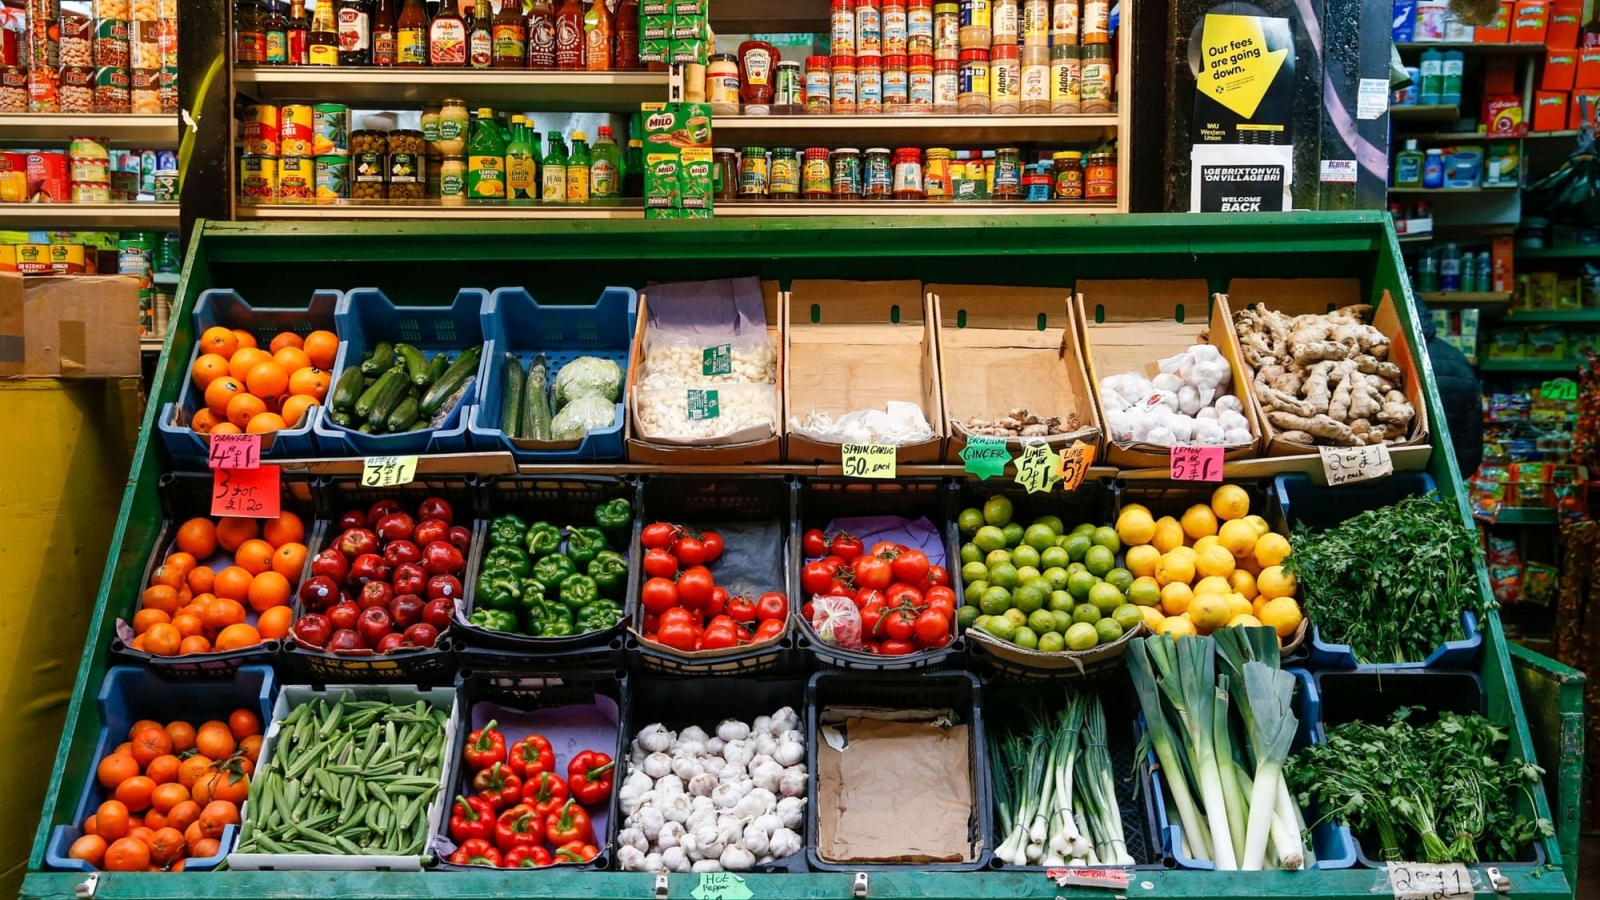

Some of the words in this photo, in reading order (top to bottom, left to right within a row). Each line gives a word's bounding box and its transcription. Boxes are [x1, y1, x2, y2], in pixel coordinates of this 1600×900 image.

[1209, 45, 1228, 57] Our
[1230, 38, 1253, 51] fees
[1211, 58, 1228, 69] are
[1230, 48, 1261, 65] going
[1213, 65, 1245, 80] down.
[998, 67, 1007, 94] Adobo
[1060, 66, 1069, 94] Adobo
[649, 117, 672, 127] MILO
[657, 166, 675, 174] MILO
[691, 166, 708, 174] MILO
[1221, 203, 1261, 212] BACK
[214, 434, 252, 442] ORANGES
[210, 444, 230, 468] 4
[963, 446, 1004, 460] GINGER
[1024, 448, 1047, 459] LIME
[1064, 448, 1084, 459] LIME
[1173, 446, 1202, 455] LEMON
[872, 463, 891, 473] EACH
[1172, 456, 1186, 479] 5
[1328, 453, 1356, 471] 2
[366, 465, 384, 486] 3
[1020, 458, 1034, 482] 5
[1062, 458, 1075, 483] 5
[1347, 470, 1365, 480] each
[215, 468, 231, 499] 3
[231, 482, 258, 496] for
[225, 497, 263, 511] £1.20
[706, 873, 729, 884] Hot
[1394, 867, 1420, 891] 2
[702, 884, 730, 893] Pepper
